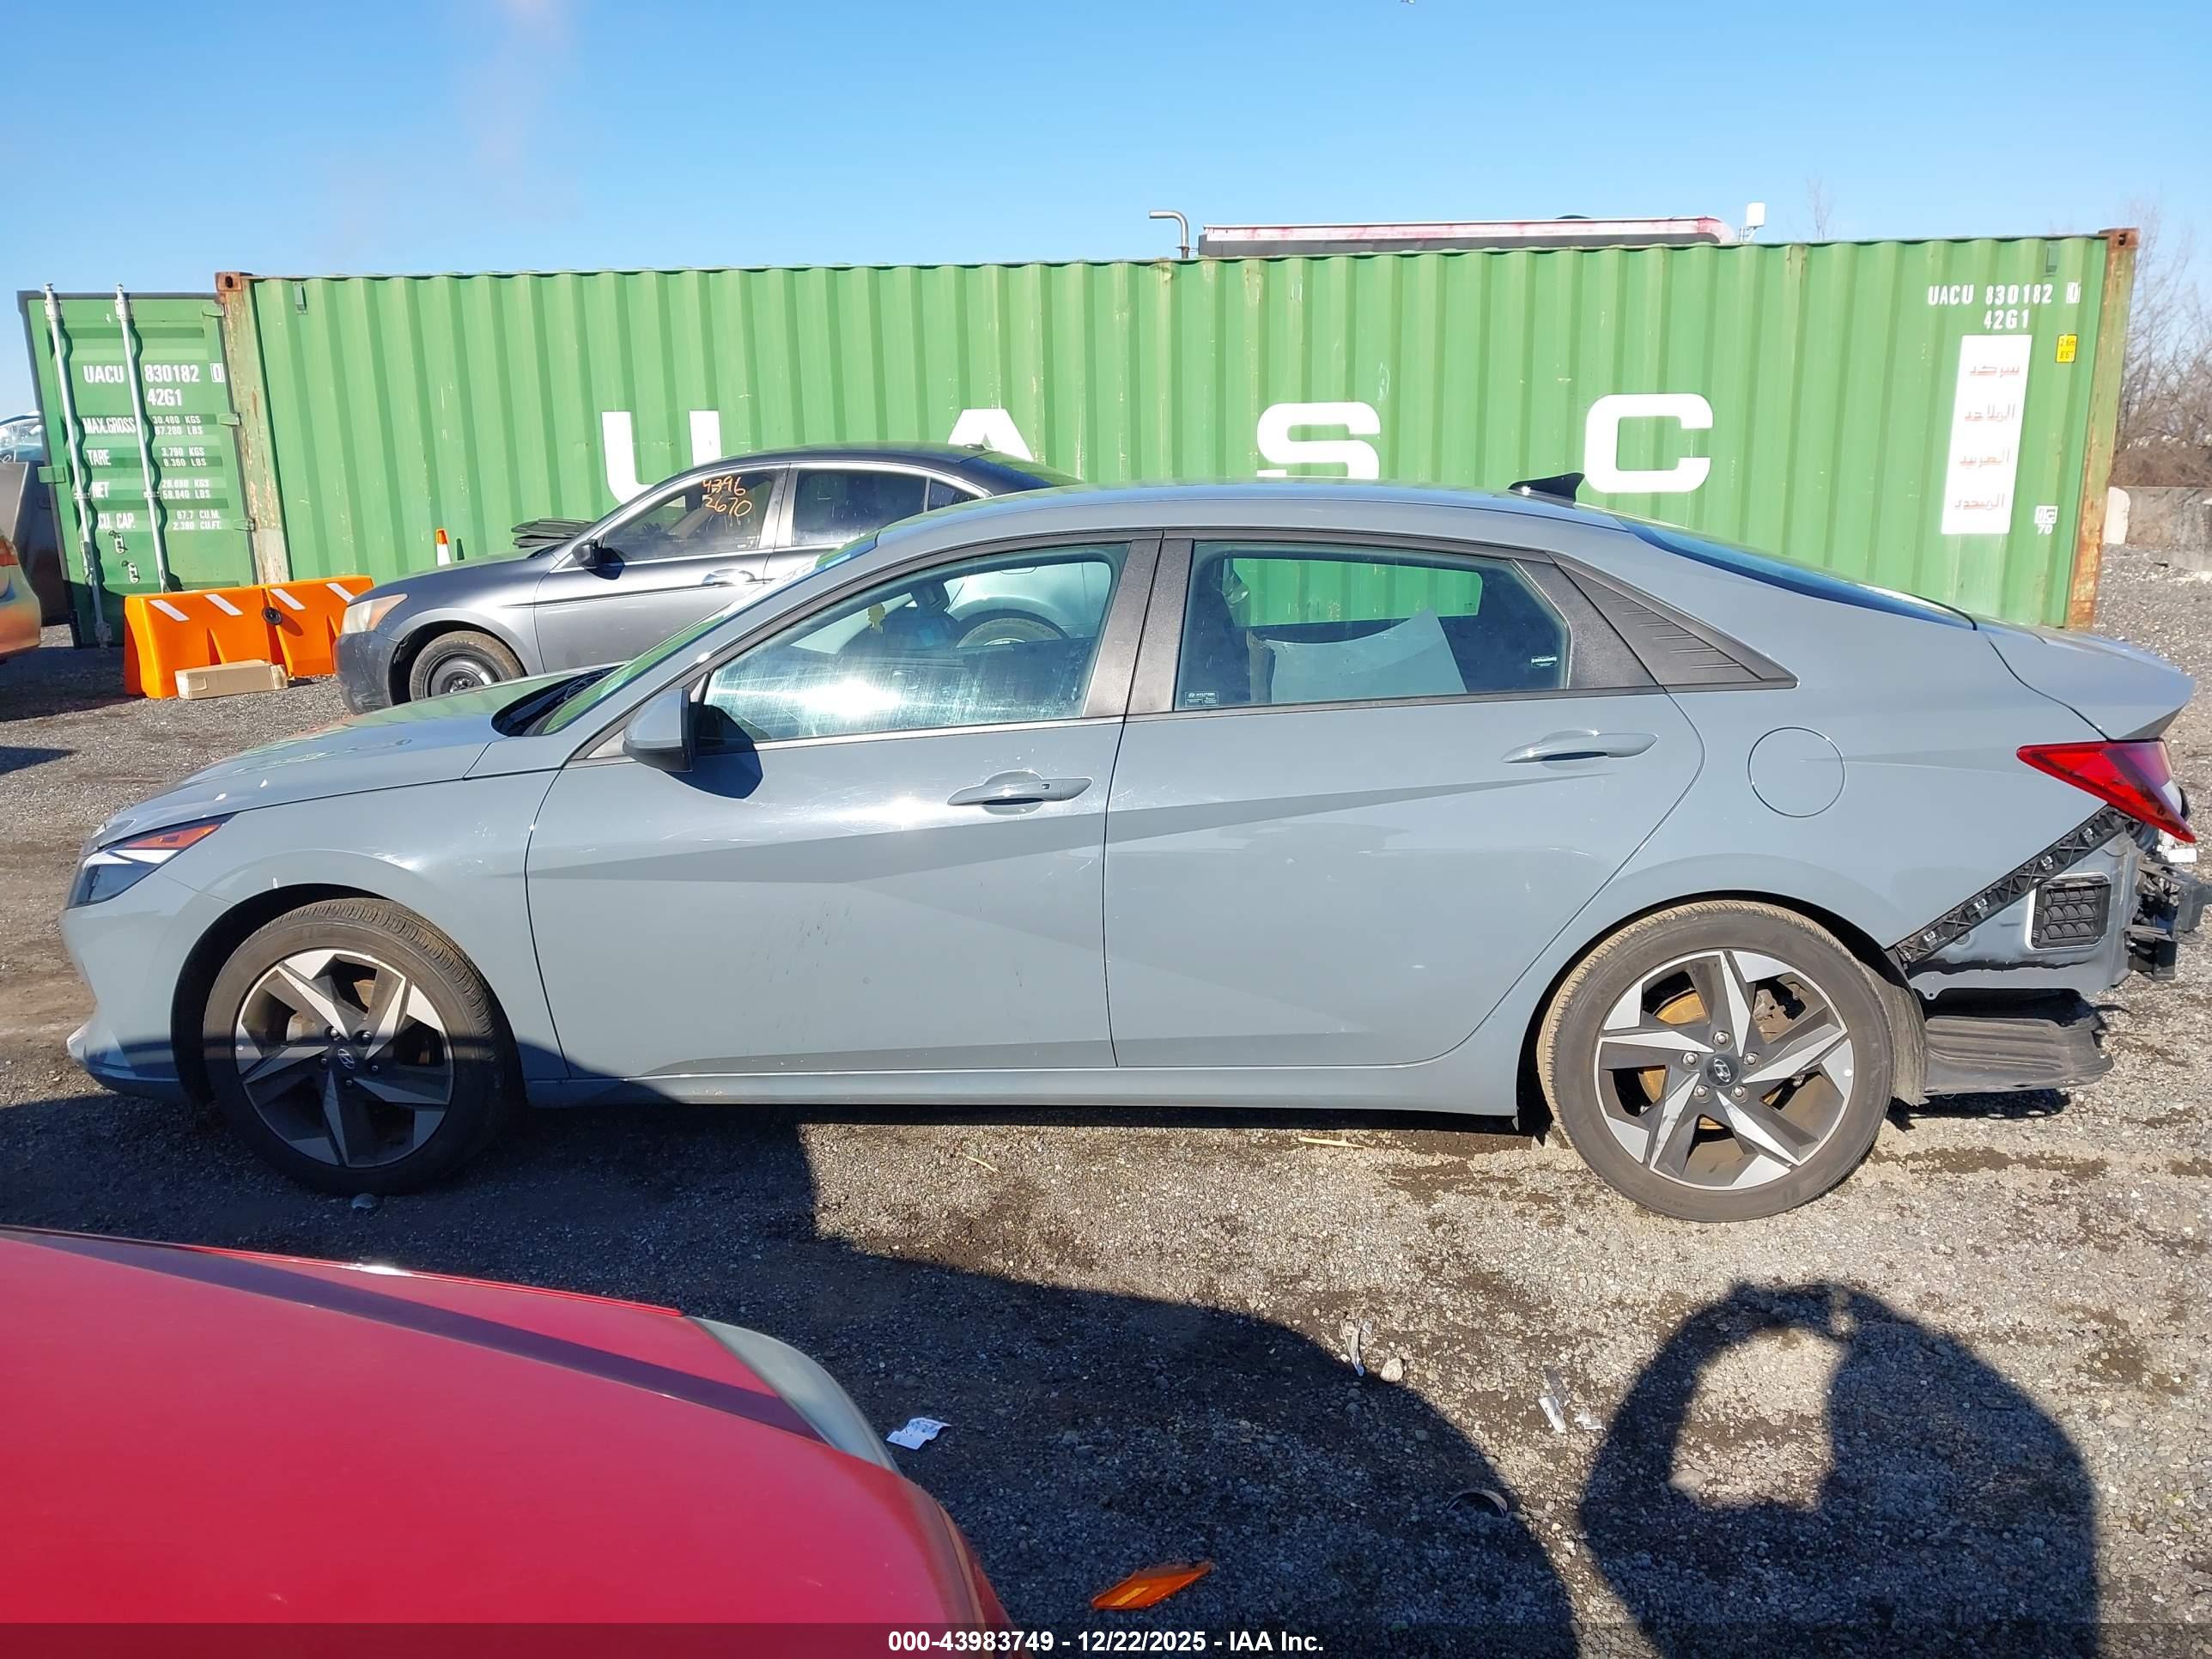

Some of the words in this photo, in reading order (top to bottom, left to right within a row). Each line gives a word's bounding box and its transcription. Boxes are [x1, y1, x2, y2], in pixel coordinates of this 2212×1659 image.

[1928, 284, 1974, 306] UACU
[1984, 283, 2053, 306] 830182
[1984, 309, 2029, 330] 42G1
[82, 365, 125, 383] UACU
[144, 364, 200, 383] 830182
[147, 388, 183, 406] 42G1
[185, 415, 201, 424] KGS
[187, 426, 204, 435] LBS
[87, 449, 112, 466] TARE
[189, 447, 205, 457] KGS
[191, 458, 207, 466] LBS
[91, 482, 110, 498] NET
[193, 479, 210, 488] KGS
[702, 475, 746, 495] 4396
[195, 489, 210, 499] LBS
[703, 495, 752, 516] 2670
[117, 513, 136, 529] CAP.
